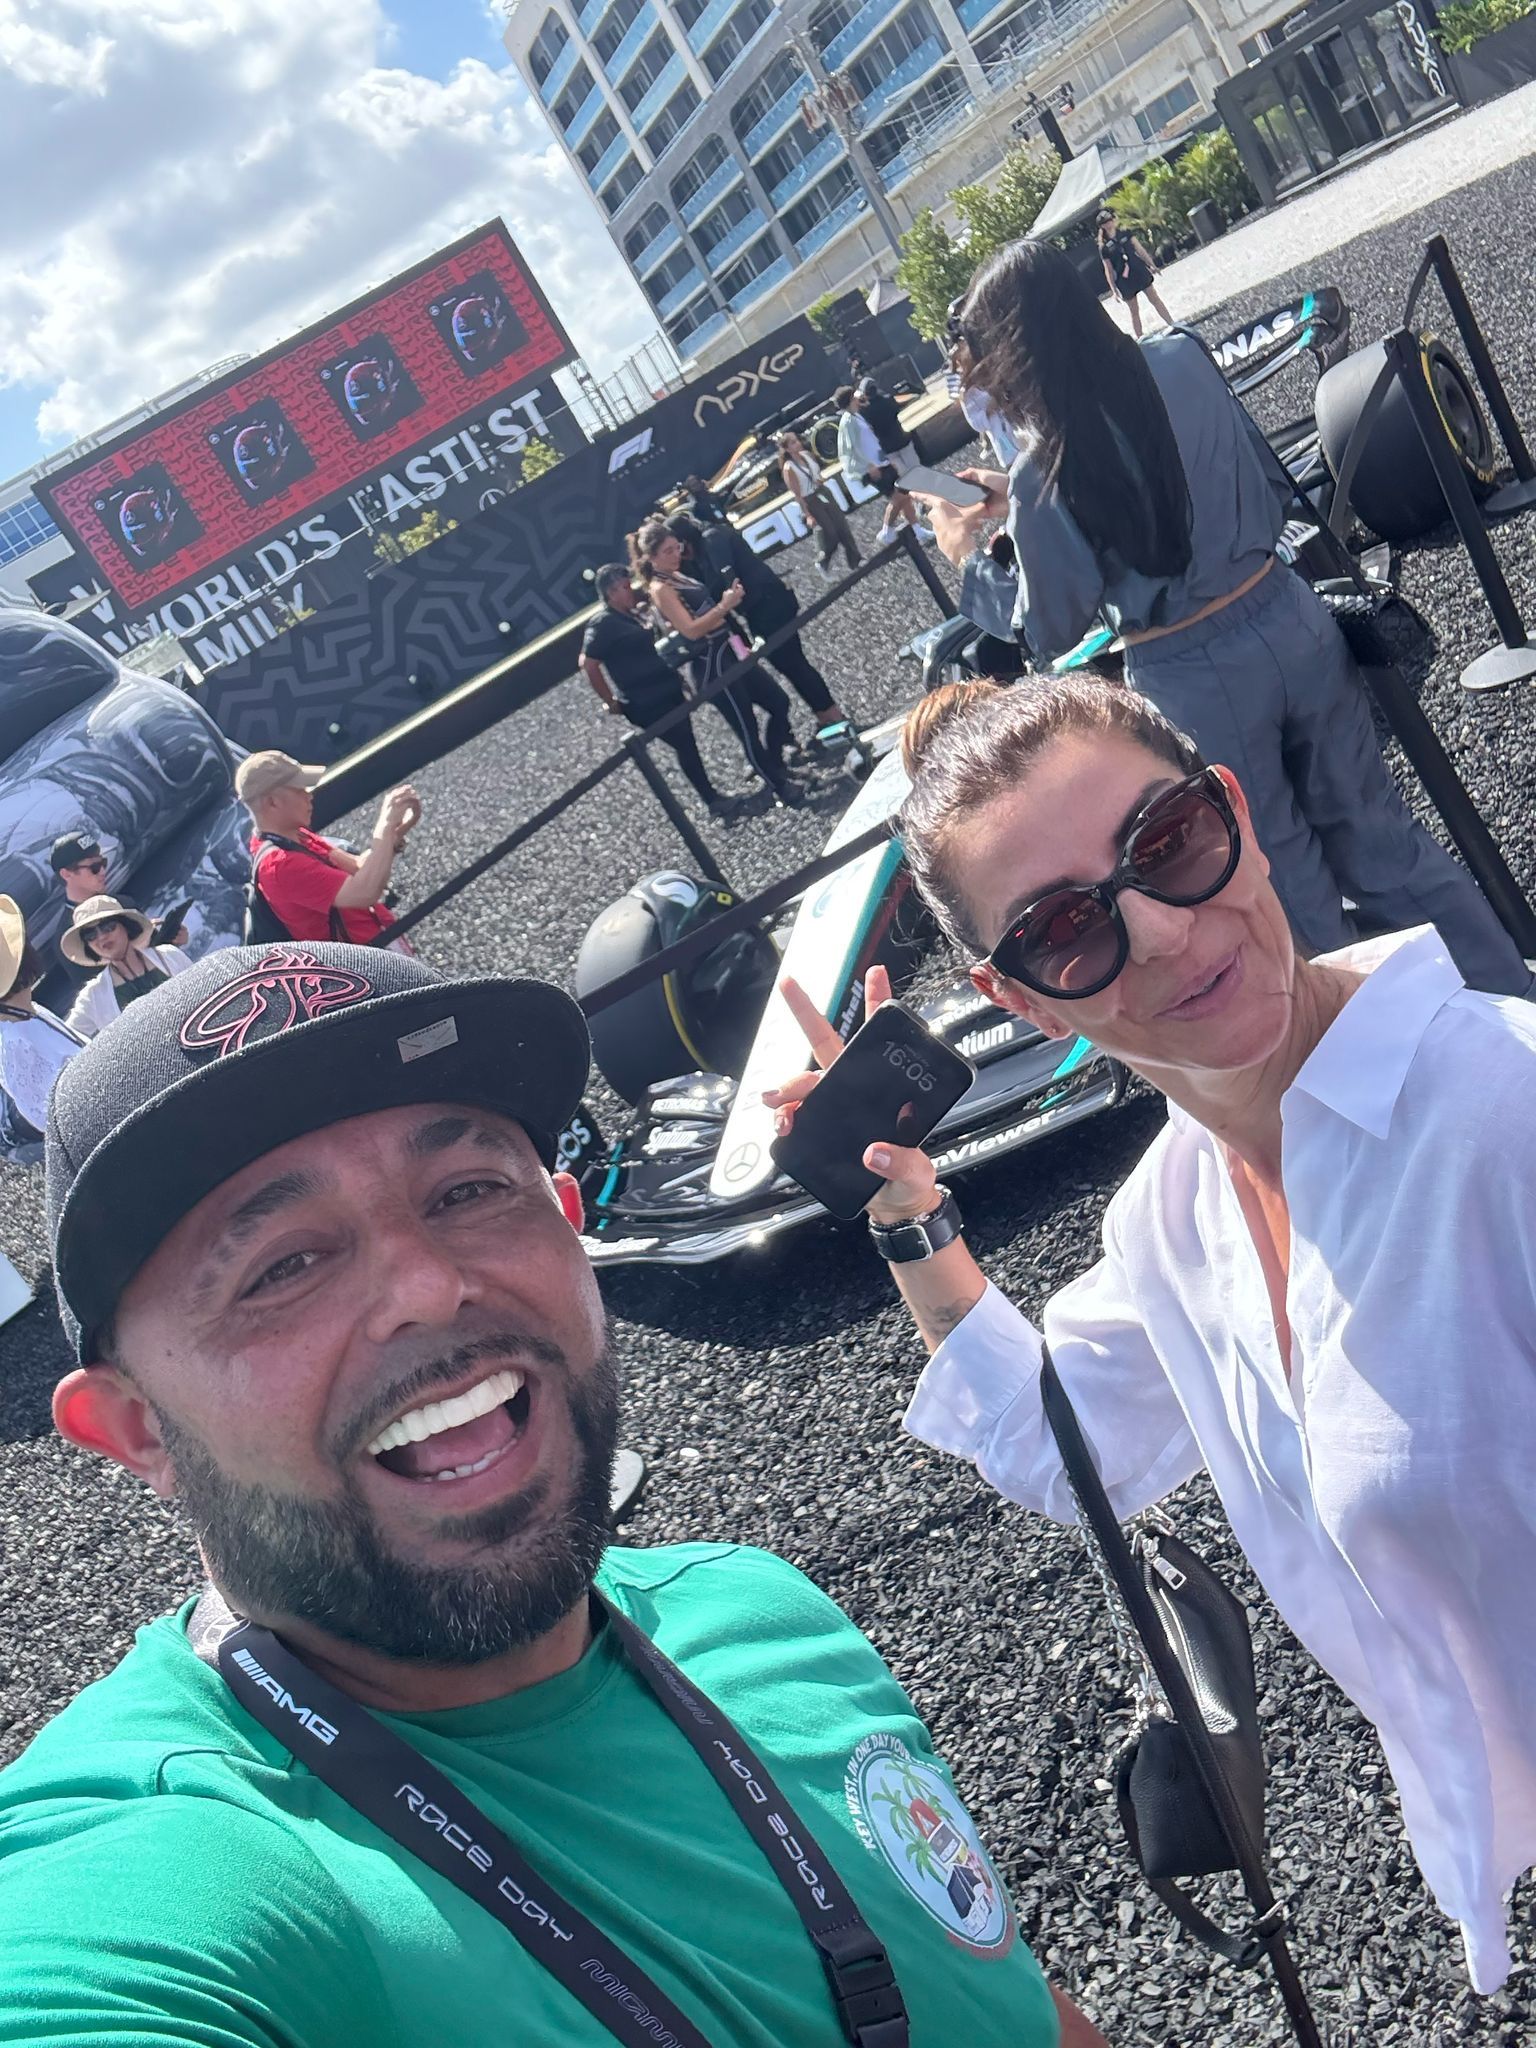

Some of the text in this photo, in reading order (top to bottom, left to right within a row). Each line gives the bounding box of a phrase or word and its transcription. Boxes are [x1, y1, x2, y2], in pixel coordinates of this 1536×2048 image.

[882, 1040, 937, 1091] 16:05
[712, 1739, 768, 1805] DAY
[766, 1811, 834, 1912] RACE
[852, 1817, 877, 1850] KEY
[394, 1783, 687, 2048] RACE DAY MIAM
